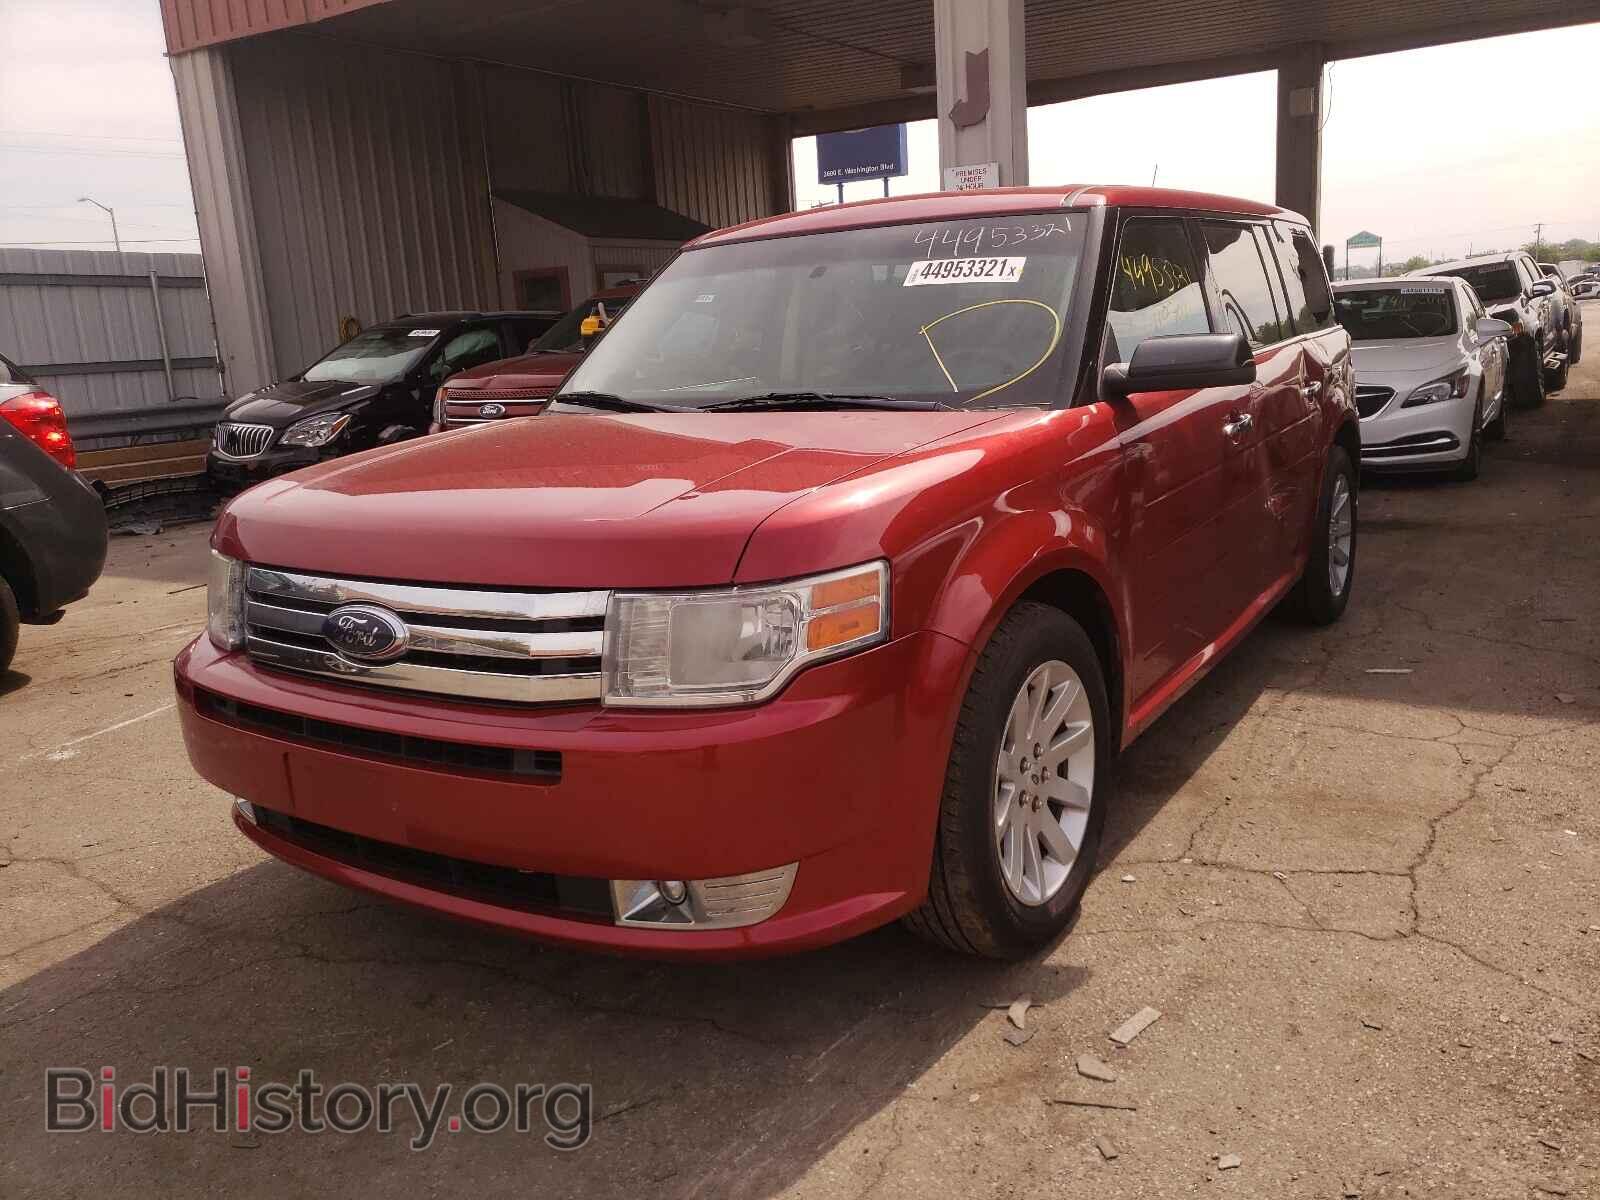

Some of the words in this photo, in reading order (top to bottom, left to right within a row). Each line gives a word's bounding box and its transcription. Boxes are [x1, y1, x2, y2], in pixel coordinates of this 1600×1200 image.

[844, 164, 879, 175] Washington
[956, 168, 988, 177] PREMISES
[960, 176, 985, 184] UNDER
[913, 216, 1071, 258] 44953321
[336, 615, 379, 647] Ford
